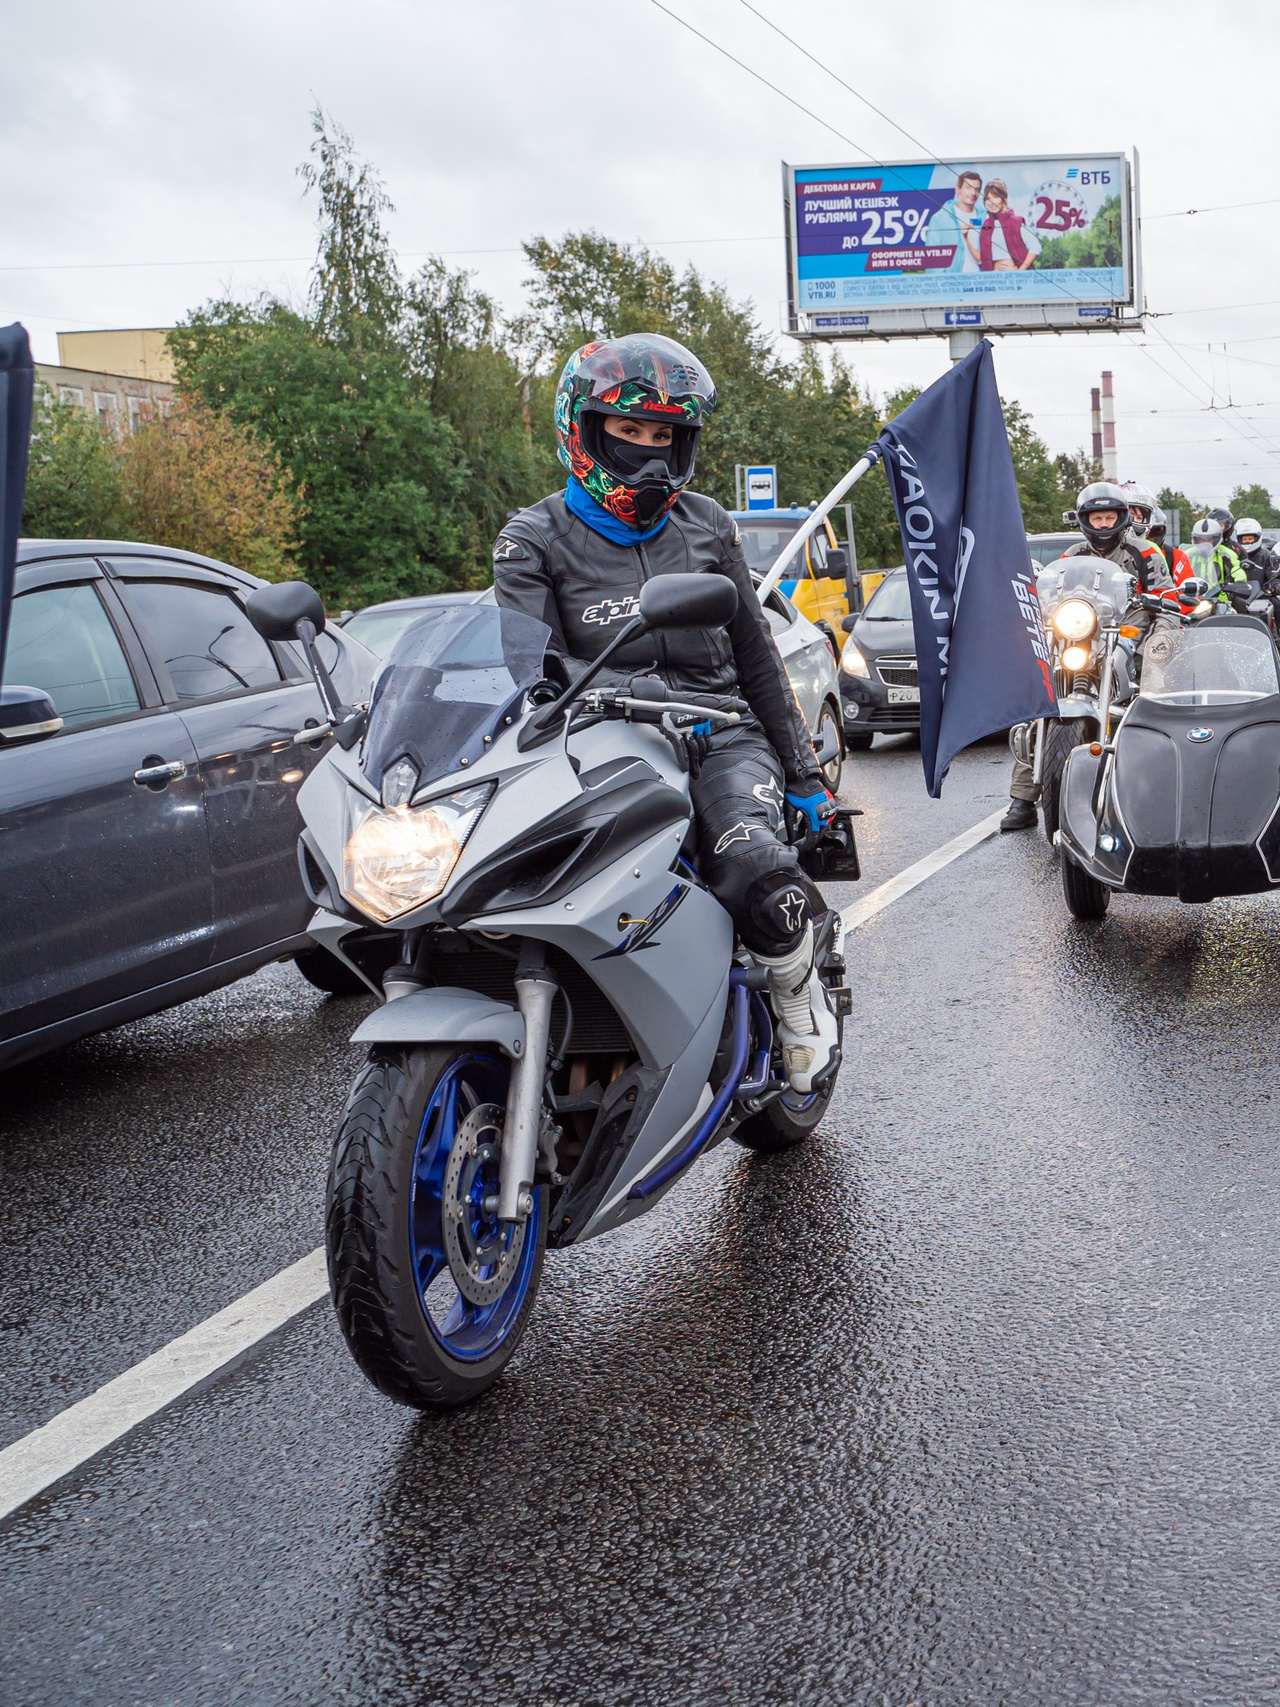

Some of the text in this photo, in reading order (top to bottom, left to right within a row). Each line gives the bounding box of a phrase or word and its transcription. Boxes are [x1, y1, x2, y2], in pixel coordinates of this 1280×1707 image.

[1081, 171, 1111, 185] ВТБ
[804, 182, 877, 194] ДЕБЕТОВАЯ КАРТА
[804, 196, 899, 211] ЛУЧШИЙ КЕШБЭК
[805, 212, 857, 224] РУБЛЯМИ
[1036, 196, 1086, 231] 25%
[842, 208, 929, 249] ДО 25%
[872, 249, 952, 260] ОФОРМИТЕ НА VTB.RU
[872, 258, 922, 268] ИЛИ В ОФИСЕ
[815, 281, 836, 290] 1000
[808, 291, 836, 300] VTB.RU
